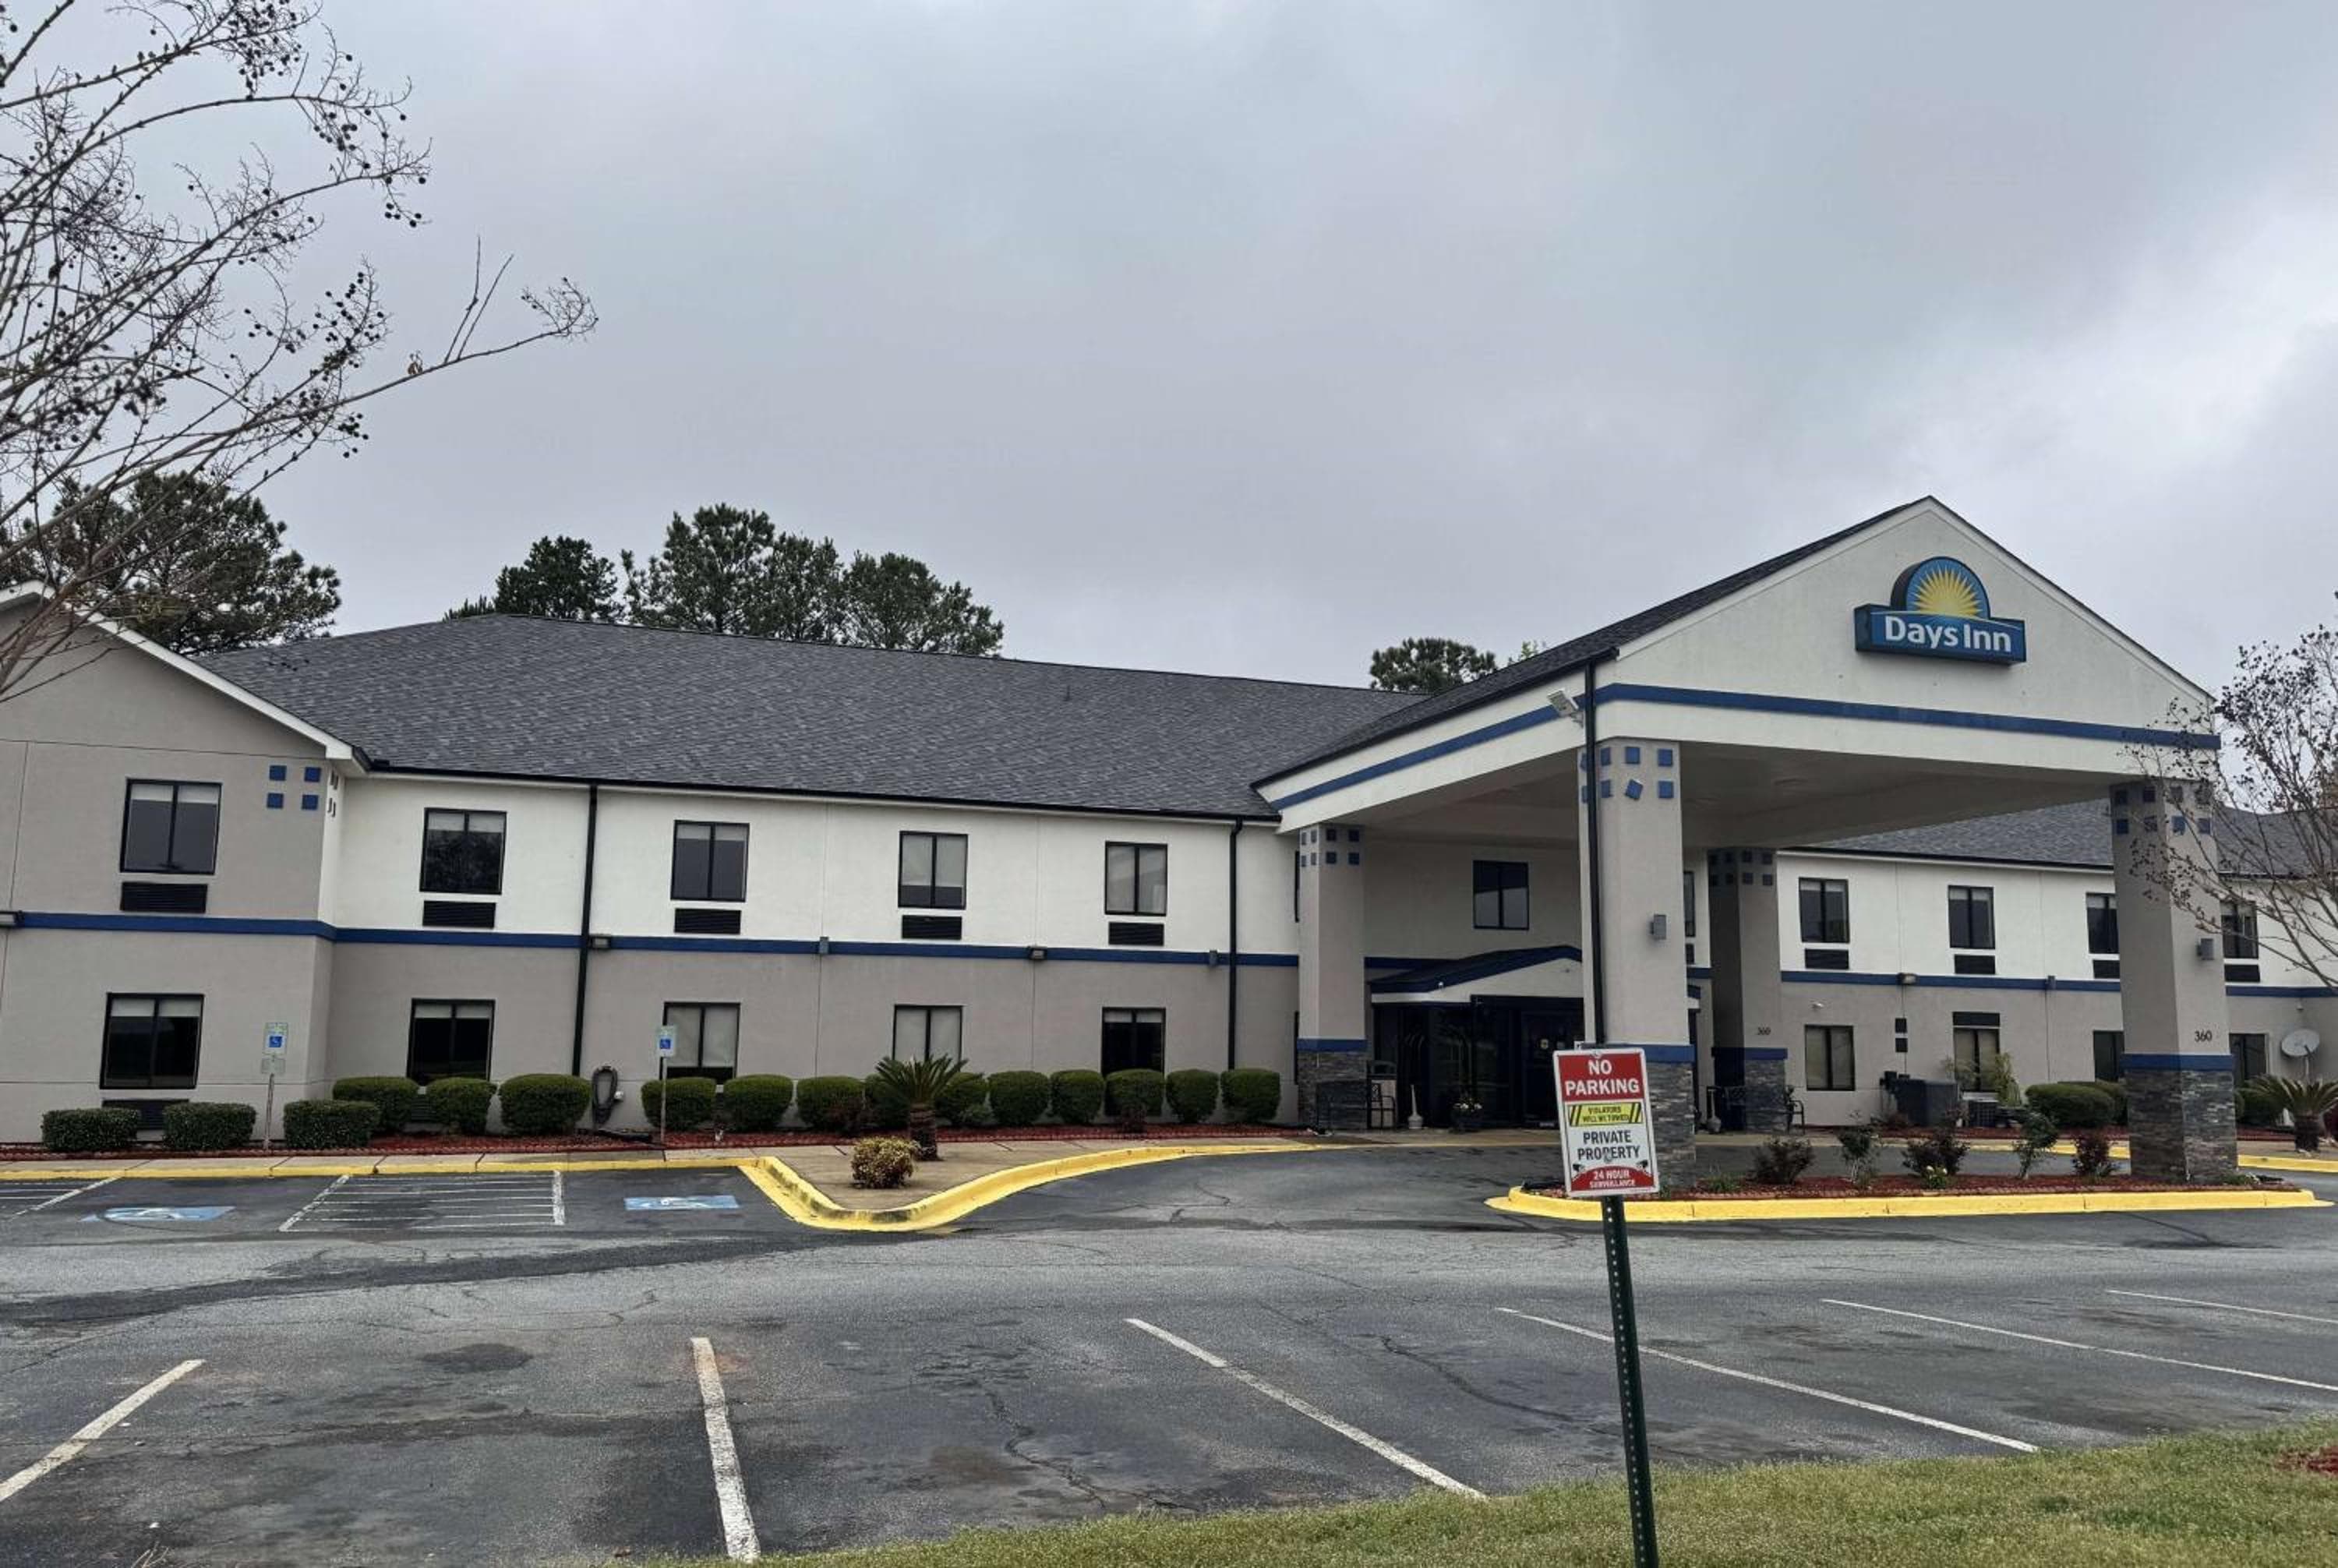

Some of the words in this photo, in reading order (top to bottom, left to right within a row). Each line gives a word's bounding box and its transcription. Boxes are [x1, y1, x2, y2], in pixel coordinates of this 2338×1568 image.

[1885, 616, 1958, 648] Days
[1964, 623, 2011, 652] Inn
[2195, 1029, 2213, 1042] 360
[1588, 1059, 1612, 1075] NO
[1565, 1078, 1640, 1096] PARKING
[1583, 1130, 1633, 1144] PRIVATE
[1577, 1145, 1640, 1160] PROPERTY
[1593, 1170, 1605, 1180] 24
[1606, 1169, 1630, 1180] HOUR
